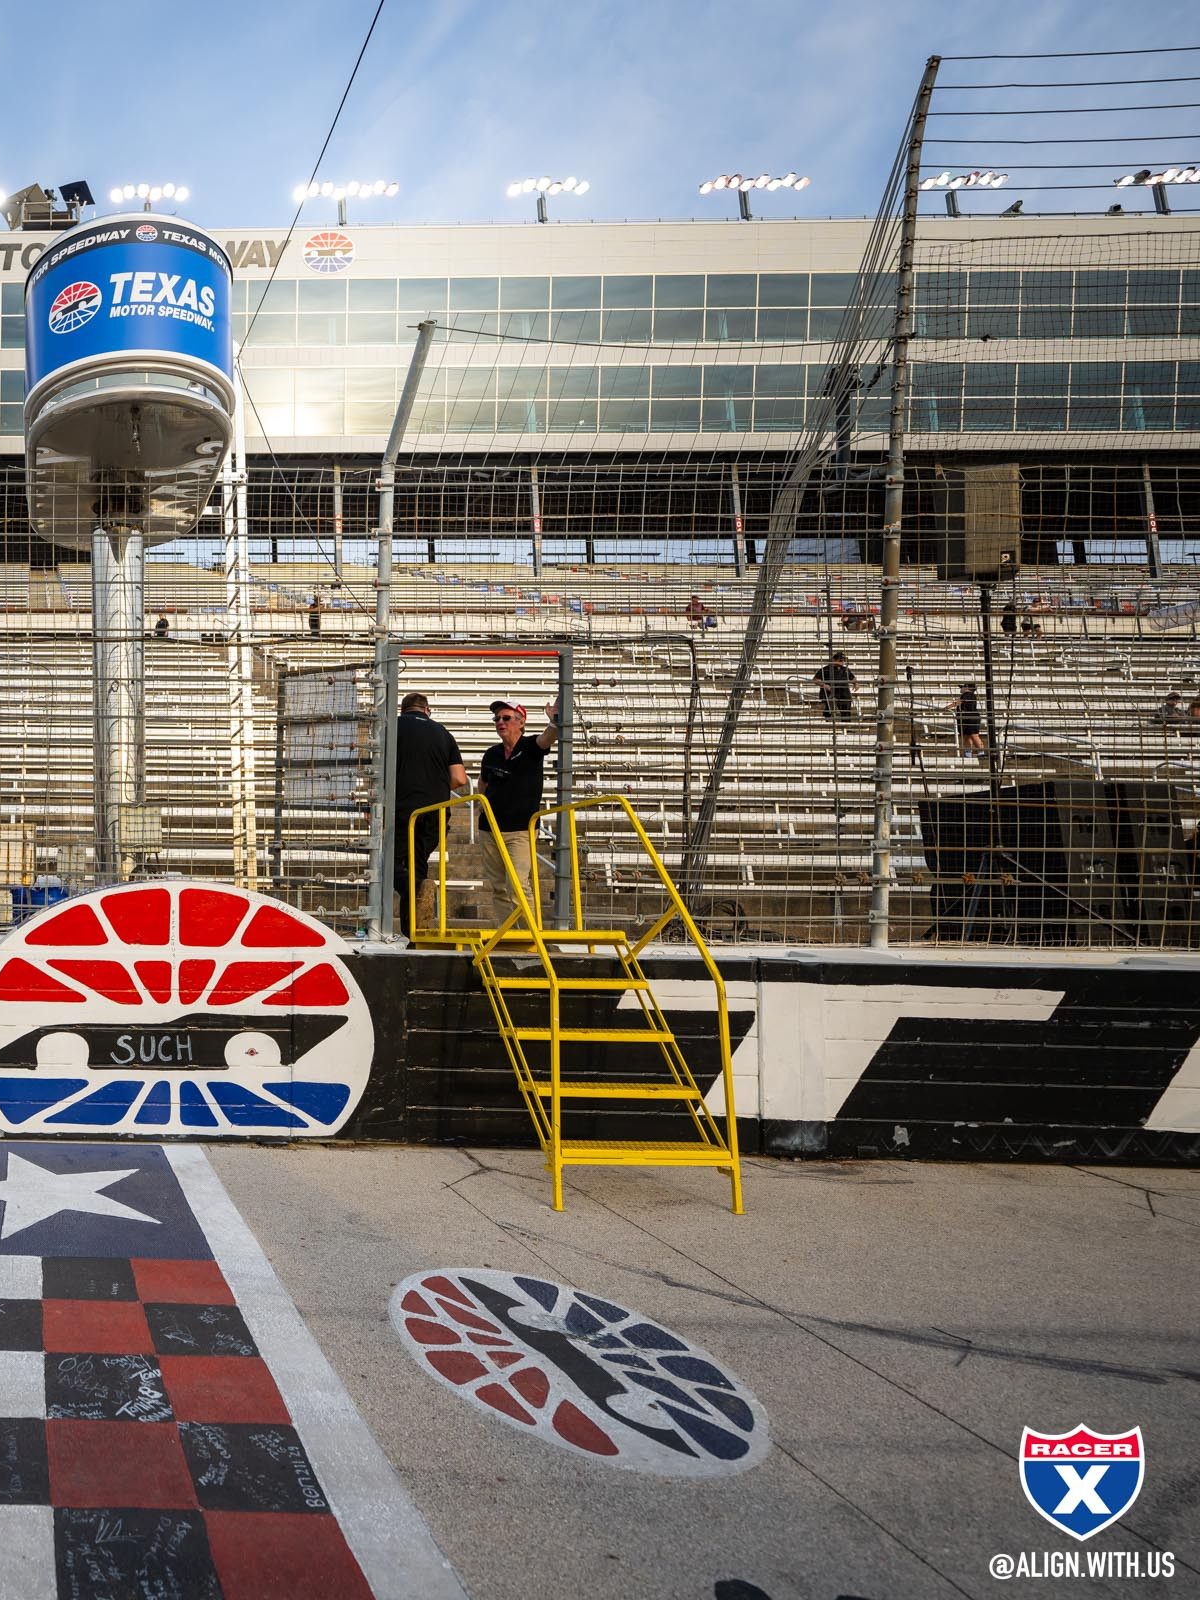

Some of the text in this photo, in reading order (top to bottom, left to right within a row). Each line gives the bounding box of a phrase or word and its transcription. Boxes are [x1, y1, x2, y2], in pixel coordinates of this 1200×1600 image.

[50, 229, 132, 266] SPEEDWAY
[162, 230, 207, 251] TEXAS
[109, 271, 215, 317] TEXAS
[109, 304, 156, 319] MOTOR
[110, 1034, 193, 1065] SUCH
